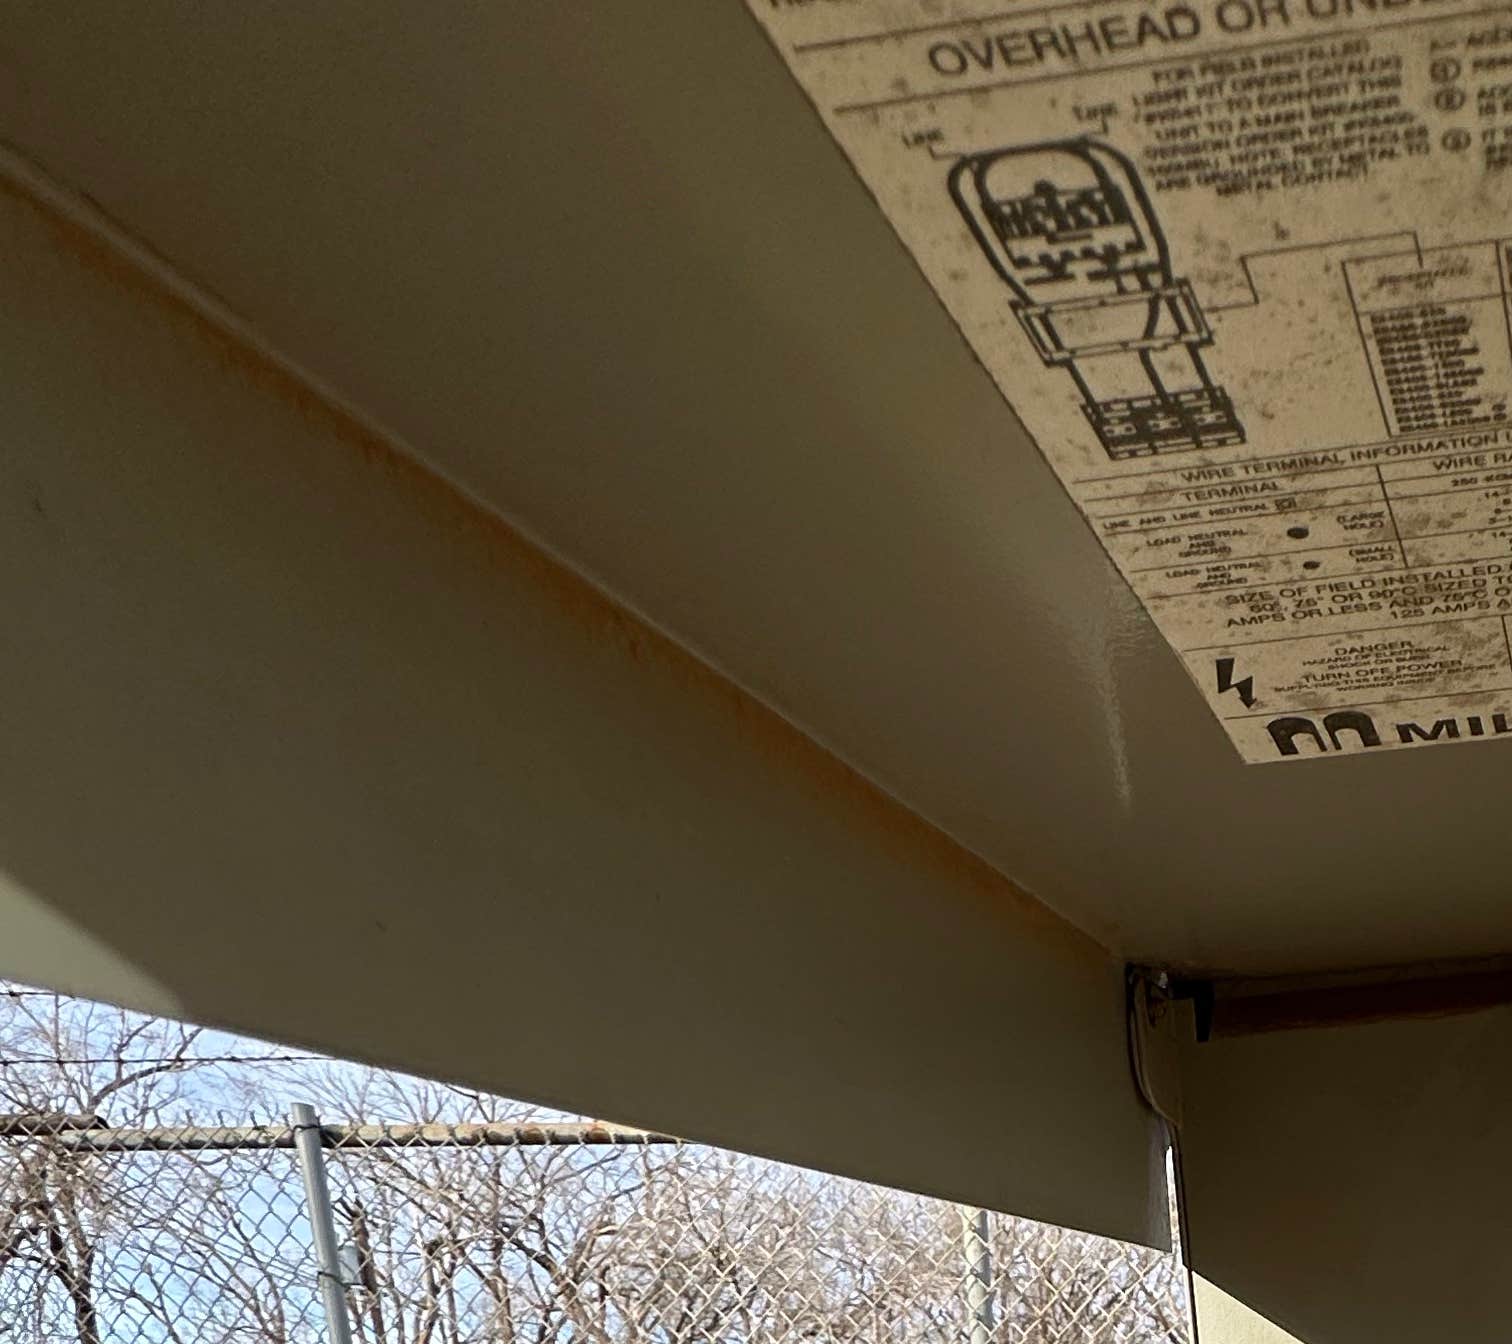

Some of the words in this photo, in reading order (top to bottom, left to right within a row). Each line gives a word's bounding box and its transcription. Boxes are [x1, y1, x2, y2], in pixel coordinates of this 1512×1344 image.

[928, 5, 1200, 76] OVERHEAD
[1215, 0, 1290, 33] OR
[1181, 467, 1234, 482] WIRE
[1350, 433, 1498, 461] INFORMATION
[1433, 456, 1485, 470] WIRE
[1183, 482, 1281, 501] TERMINAL
[1225, 591, 1274, 605] SIZE
[1279, 587, 1306, 597] OF
[1315, 578, 1376, 594] FIELD
[1382, 565, 1502, 586] INSTALLED
[1331, 592, 1363, 603] OR
[1424, 579, 1486, 593] SIZED
[1227, 613, 1285, 627] AMPS
[1292, 609, 1322, 620] OR
[1328, 602, 1382, 615] LESS
[1390, 596, 1434, 608] AND
[1391, 608, 1424, 619] 125
[1432, 601, 1490, 614] AMPS
[1335, 640, 1413, 655] DANGER
[1302, 671, 1350, 682] TURN
[1355, 667, 1389, 676] OFF
[1396, 659, 1462, 672] POWER
